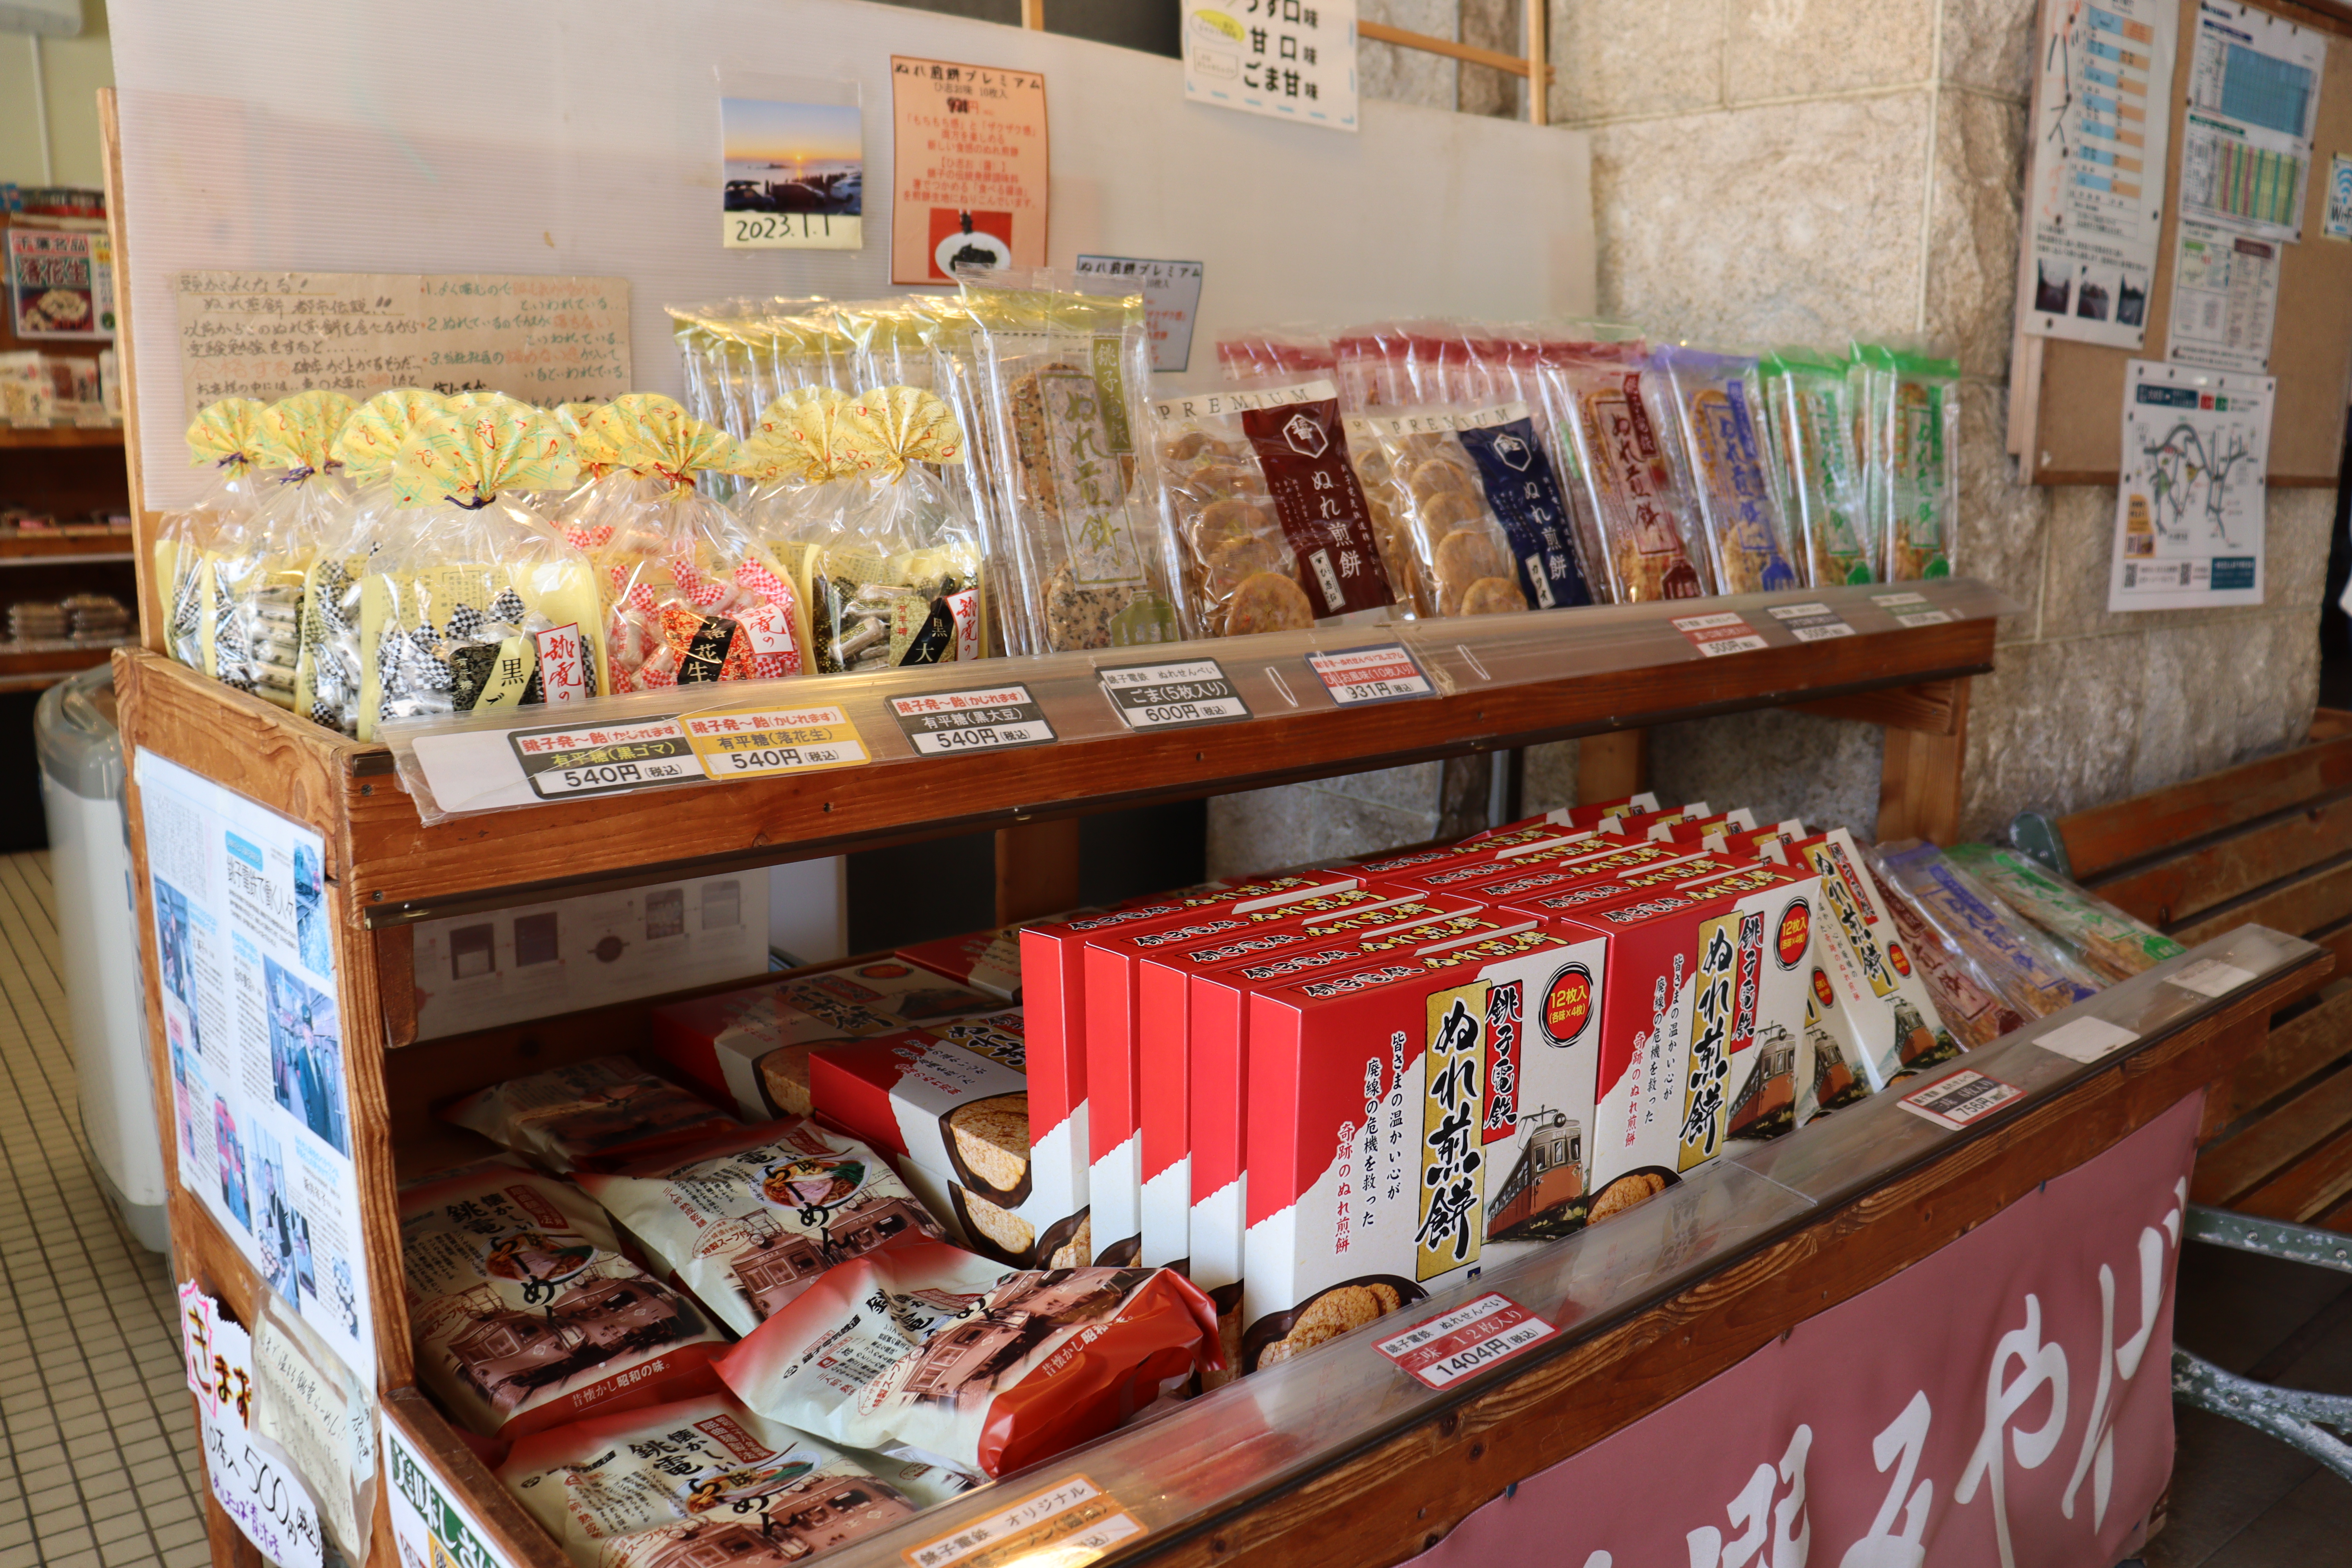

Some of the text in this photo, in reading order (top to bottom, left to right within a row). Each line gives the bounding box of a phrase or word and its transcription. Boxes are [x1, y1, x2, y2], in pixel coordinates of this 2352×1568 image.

[1245, 0, 1318, 29] す口味
[1250, 25, 1318, 65] 甘口味
[895, 63, 1040, 89] ぬれ煎餅プレミアム
[1244, 62, 1318, 100] ごま甘味
[736, 214, 830, 242] 2023.1.1
[19, 256, 90, 287] 落花生
[1080, 261, 1200, 277] ぬれ煎餅プレミアム
[1095, 343, 1129, 445] 銚子電鉄
[1158, 388, 1310, 420] PREMIUM
[1392, 408, 1510, 434] PREMIUM
[1065, 390, 1121, 568] ぬれ煎餅
[1612, 414, 1664, 542] ぬれ煎餅
[1311, 470, 1362, 579] ぬれ煎餅
[1524, 481, 1567, 581] ぬれ煎餅
[840, 623, 867, 644] 黒大豆
[897, 604, 908, 637] 有平糖
[544, 634, 583, 702] 銚電の
[1106, 667, 1216, 685] 銚子電鉄 ぬれせんべい
[1130, 681, 1228, 704] ごま(5枚入り)
[1347, 682, 1391, 699] 931円
[921, 708, 1023, 730] 有平糖(黒大豆)
[1145, 704, 1227, 722] 600円 (税込)
[551, 742, 675, 768] 有平糖(黒ゴマ)
[717, 728, 833, 750] 有平糖(落花生)
[731, 749, 839, 769] 540円 (税込)
[936, 728, 1031, 748] 540円 (税込)
[565, 764, 683, 787] 540円 (税込)
[1361, 829, 1562, 873] 銚子電鉄 ぬれ煎餅
[1423, 839, 1623, 886] 銚子電鉄 ぬれ煎餅
[1481, 847, 1681, 896] 銚子電鉄 ぬれ煎餅
[1068, 877, 1321, 931] 銚子電鉄 ぬれ煎餅
[1539, 859, 1736, 909] 銚子電鉄 ぬれ煎餅
[1601, 869, 1797, 924] 銚子電鉄 ぬれ煎餅
[1134, 889, 1388, 947] 銚子電鉄 ぬれ煎餅
[1188, 903, 1445, 963] 銚子電鉄 ぬれ煎餅
[1781, 916, 1807, 938] 12枚入
[1813, 849, 1894, 989] ぬれ煎餅
[1241, 916, 1501, 980] 銚子電鉄 ぬれ煎餅
[1301, 931, 1569, 998] 銚子電鉄 ぬれ煎餅
[1549, 985, 1588, 1011] 12枚入
[1731, 916, 1762, 1043] 銚子電鉄
[1548, 1004, 1586, 1025] (各味×4枚)
[1663, 954, 1684, 1102] 皆さまの温かい心が
[1485, 986, 1523, 1130] 銚子電鉄
[1644, 975, 1667, 1125] 廃線の危機を救った
[1677, 926, 1733, 1156] ぬれ煎餅
[1624, 1031, 1646, 1148] 奇跡のぬれ煎餅
[1955, 1097, 1995, 1116] 756円
[1386, 1030, 1407, 1202] 皆さまの温かい心が
[1414, 996, 1482, 1260] ぬれ煎餅
[1361, 1057, 1383, 1229] 廃線の危機を救った
[735, 1149, 850, 1255] 電らーめん
[1334, 1121, 1356, 1256] 奇跡のぬれ煎餅
[701, 1229, 750, 1256] 特製スープ付
[1385, 1298, 1502, 1354] 銚子電鉄 ぬれせんべい
[1403, 1309, 1523, 1368] 三味 12枚入り
[1436, 1328, 1539, 1376] 1404円 (税込)
[571, 1359, 671, 1408] 昔懐かし昭和の味。
[871, 1357, 908, 1408] 特製スープ付
[666, 1428, 760, 1488] 懐かしい味
[920, 1485, 1086, 1567] 銚子電鉄 オリジナル
